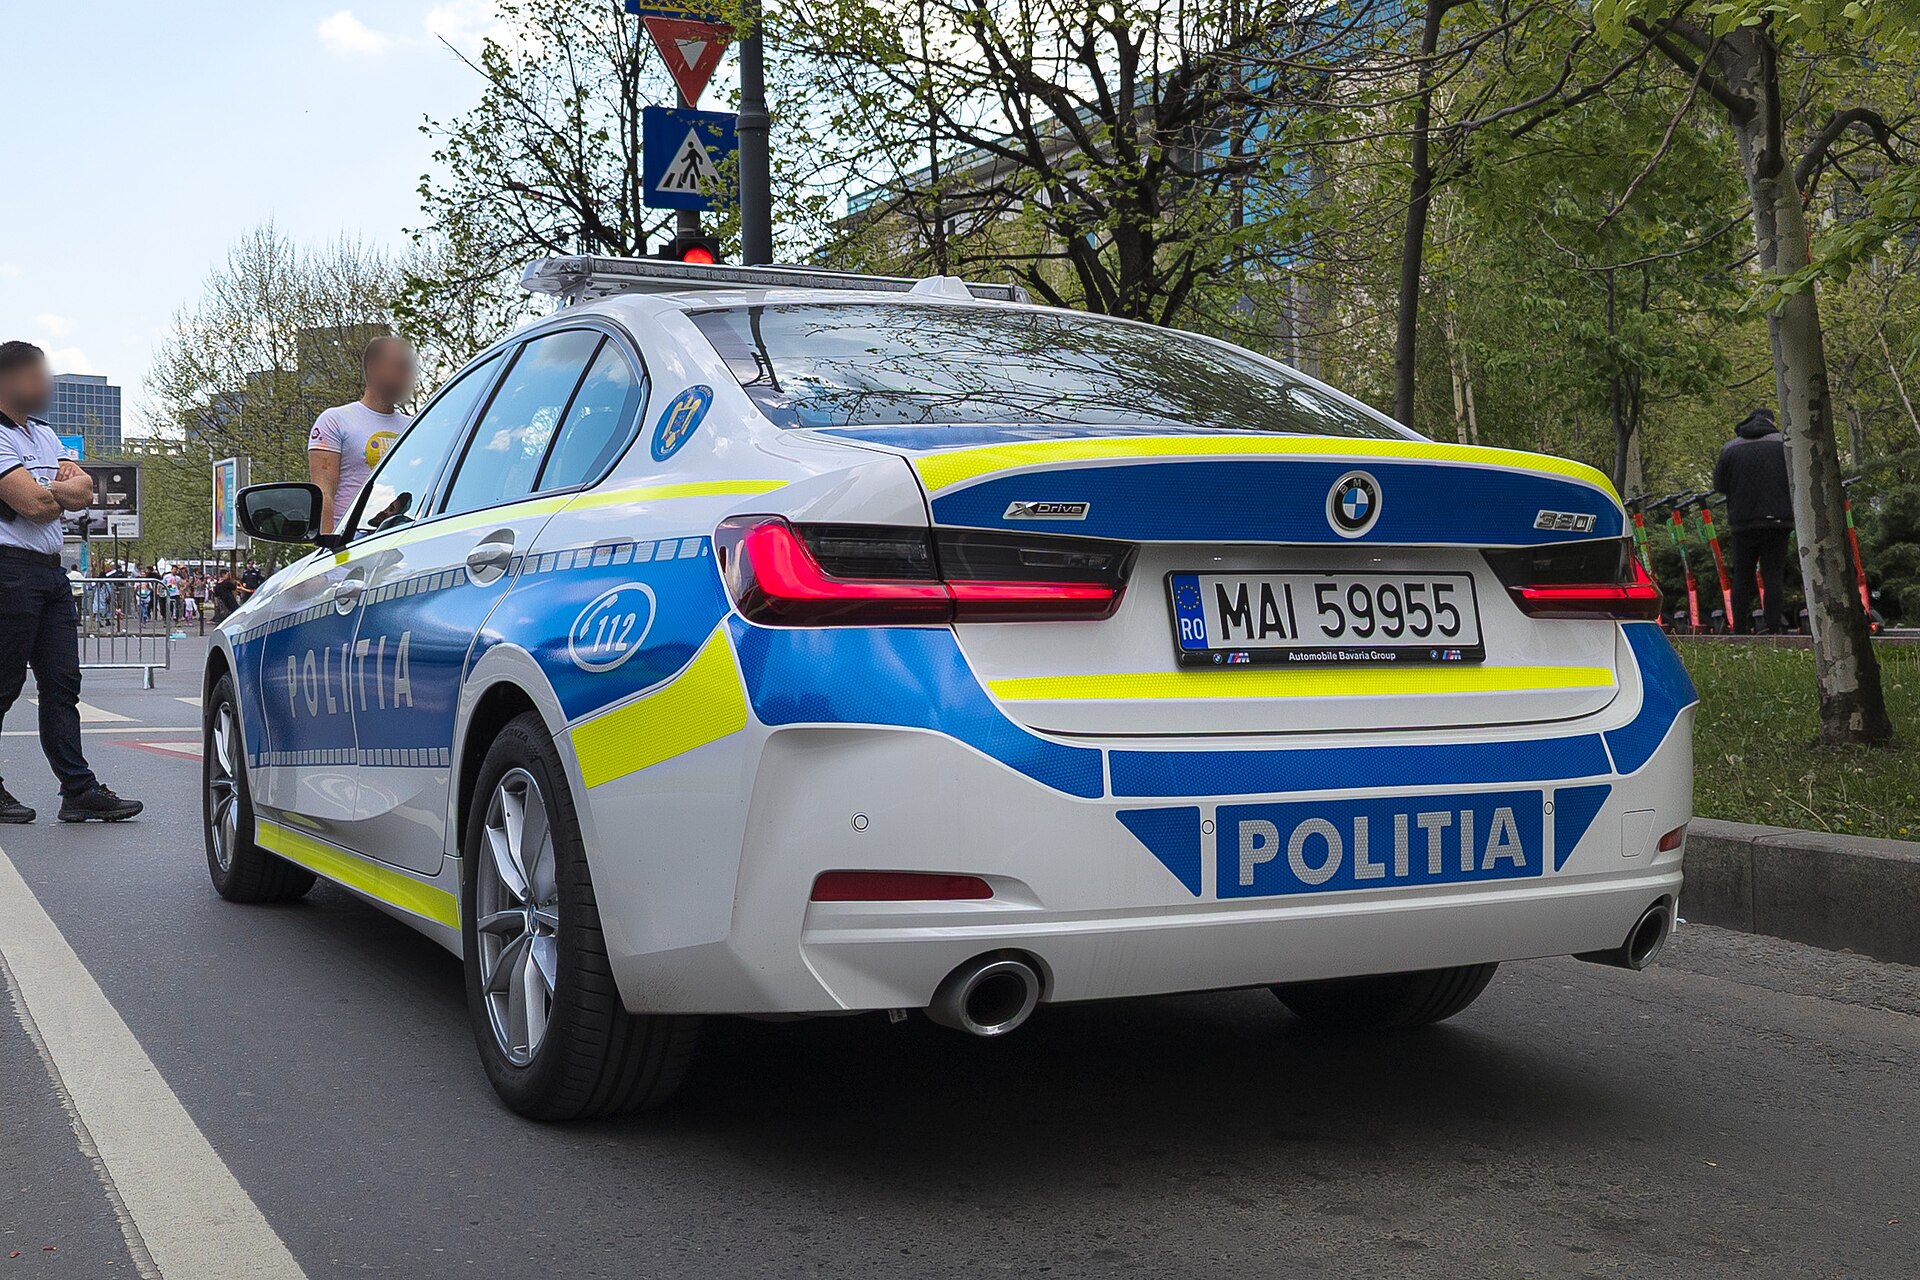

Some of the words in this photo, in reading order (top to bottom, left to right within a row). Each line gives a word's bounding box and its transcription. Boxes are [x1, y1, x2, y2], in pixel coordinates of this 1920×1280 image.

[1340, 478, 1374, 496] BMW
[1180, 617, 1205, 641] RO
[1214, 582, 1299, 640] MAI
[1314, 583, 1462, 639] 59955
[592, 612, 636, 653] 112
[287, 631, 413, 718] POLITIA
[1288, 651, 1337, 662] Automobile
[1338, 650, 1370, 661] Bavaria
[1371, 650, 1396, 662] Group
[1238, 807, 1527, 886] POLITIA
